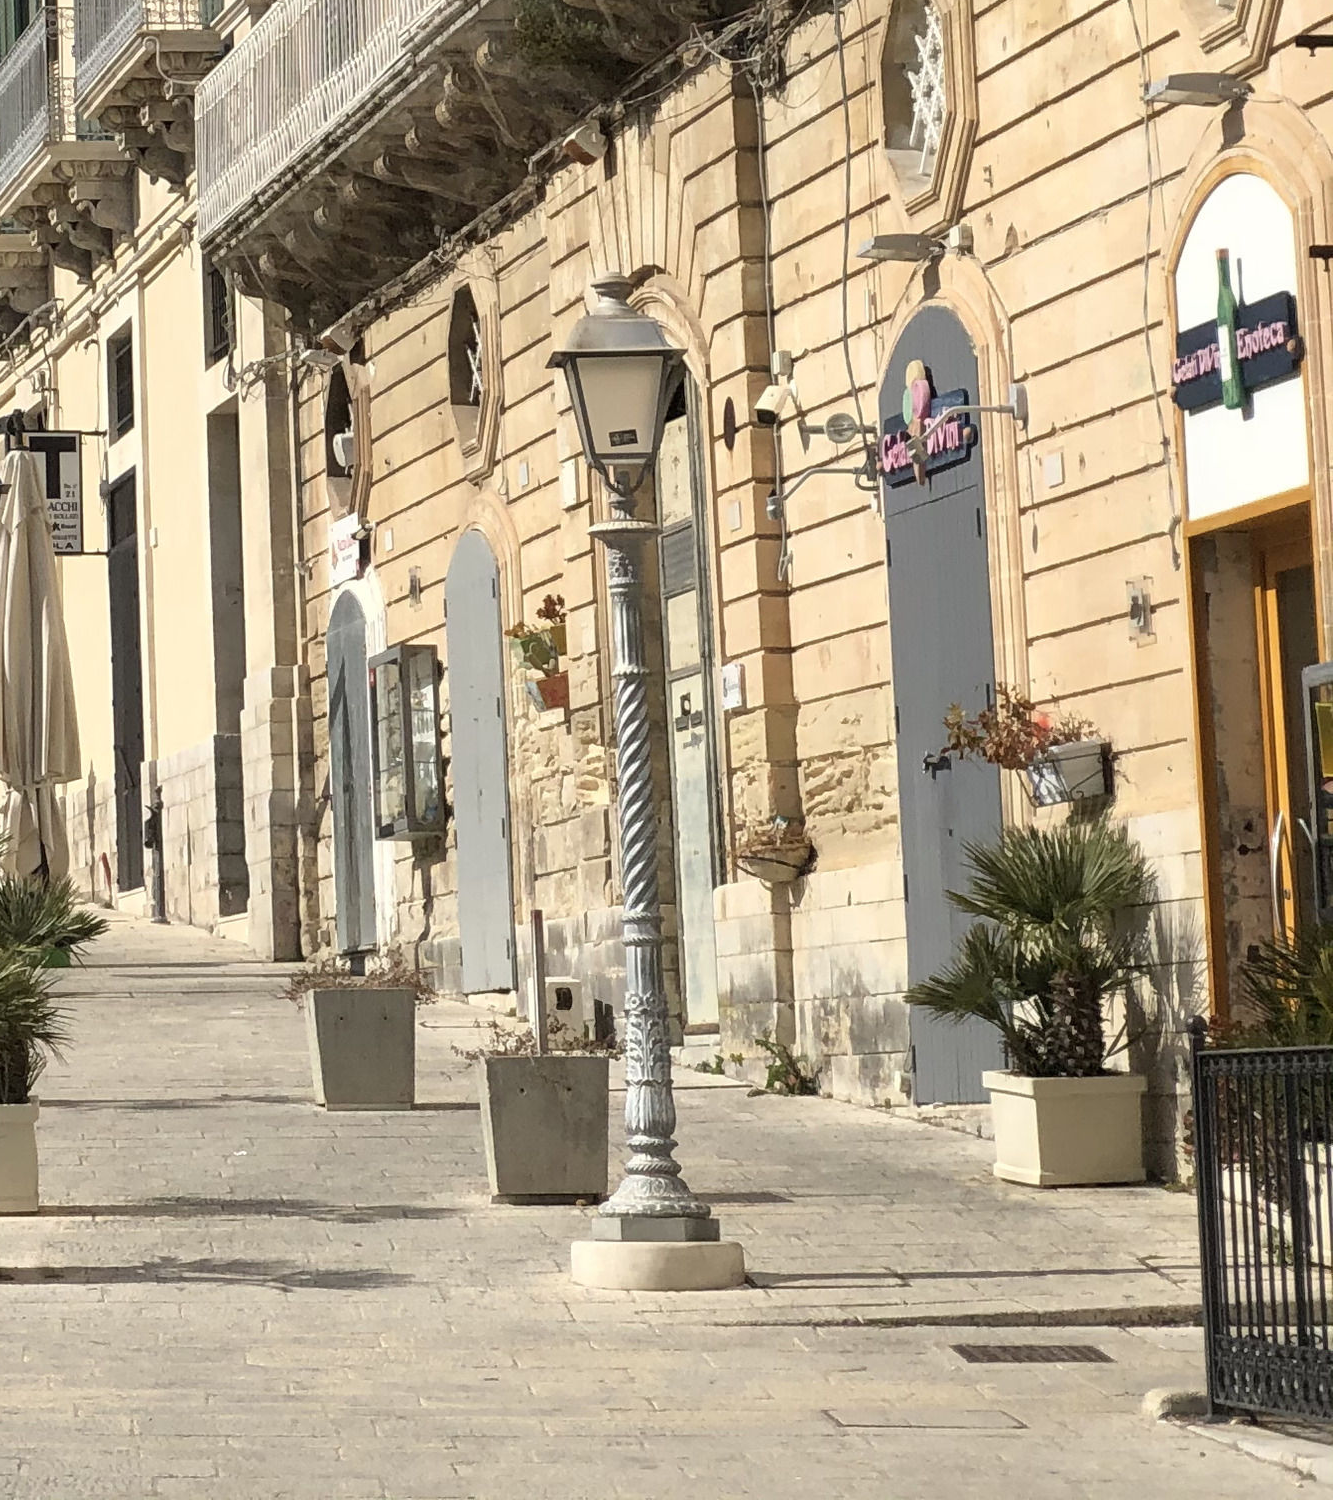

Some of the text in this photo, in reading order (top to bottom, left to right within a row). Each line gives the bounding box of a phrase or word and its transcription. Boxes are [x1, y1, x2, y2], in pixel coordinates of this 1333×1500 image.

[1196, 343, 1221, 376] DiVin
[1235, 321, 1287, 360] Enoteca
[29, 436, 76, 499] T
[47, 501, 78, 512] ACCHI
